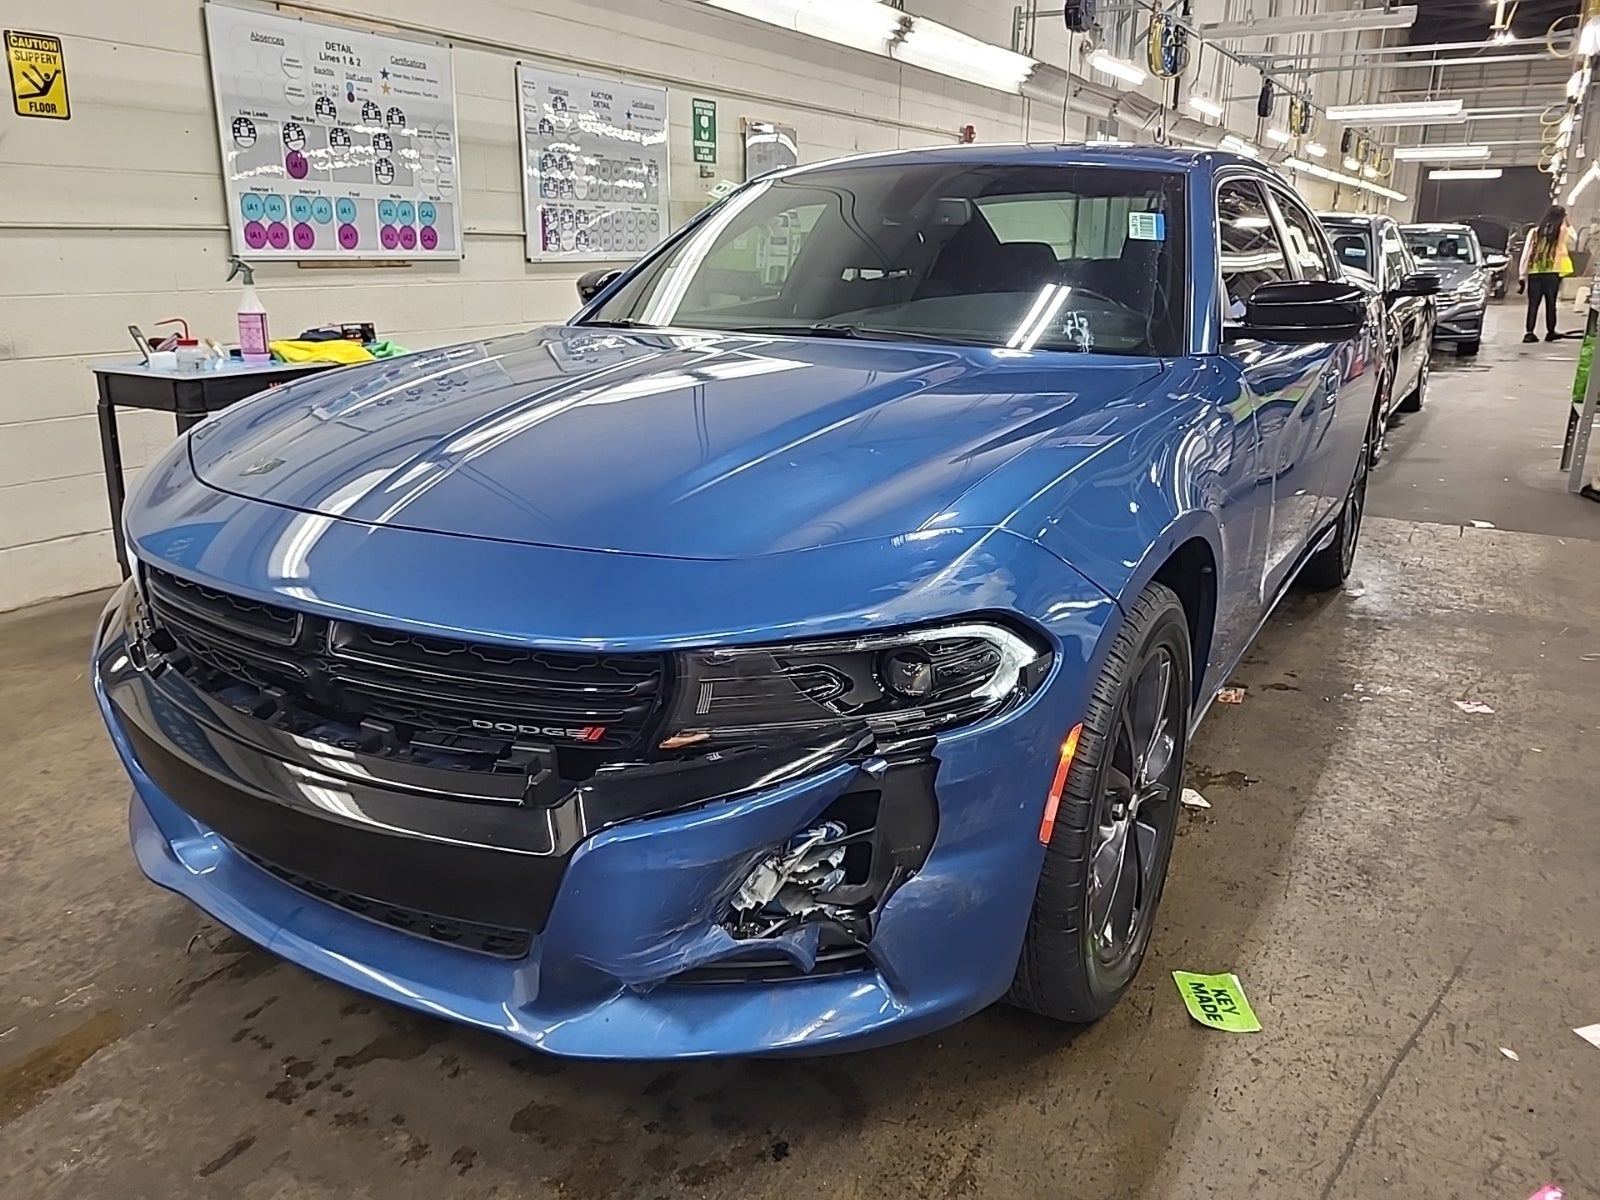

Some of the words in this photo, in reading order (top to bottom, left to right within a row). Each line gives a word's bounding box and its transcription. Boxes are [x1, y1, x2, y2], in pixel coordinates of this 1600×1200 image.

[10, 35, 57, 51] CAUTION
[250, 31, 285, 46] Absences
[325, 41, 354, 54] DETAIL
[14, 50, 57, 65] SLIPPERY
[318, 52, 341, 64] Lines
[342, 56, 347, 64] 1
[349, 57, 355, 65] &
[356, 58, 362, 67] 2
[590, 90, 613, 100] AUCTION
[29, 102, 57, 113] FLOOR
[593, 100, 611, 110] DETAIL
[472, 719, 588, 738] DODGE
[1189, 982, 1224, 1022] MADE
[1211, 989, 1240, 1016] KEY
